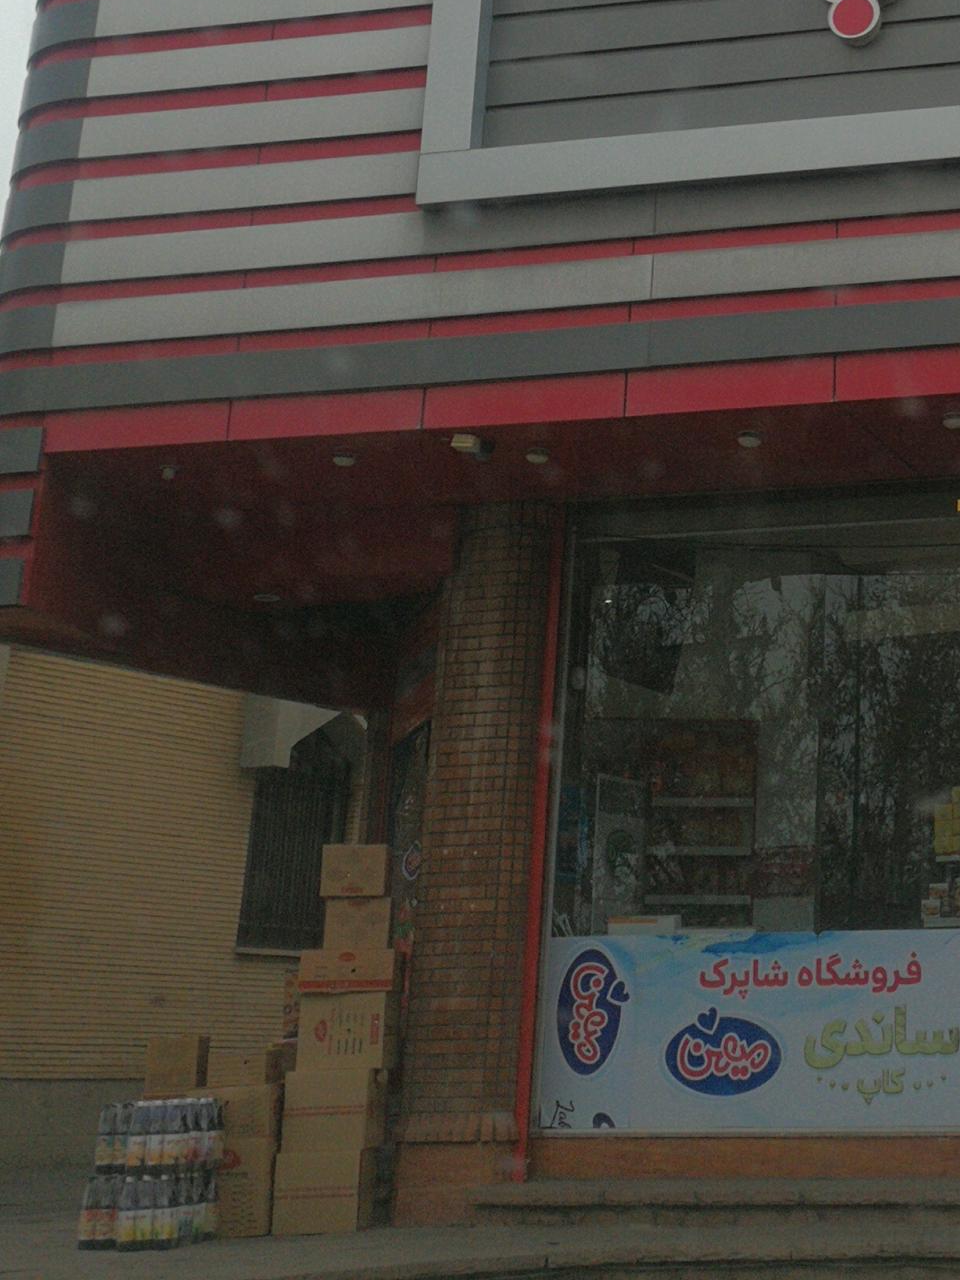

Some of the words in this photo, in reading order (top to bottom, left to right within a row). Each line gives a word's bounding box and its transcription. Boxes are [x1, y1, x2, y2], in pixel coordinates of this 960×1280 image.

[699, 957, 788, 1000] شاپرک
[796, 951, 923, 993] فروشگاه
[569, 962, 607, 1065] میهن
[676, 1032, 772, 1081] میهن
[803, 1004, 960, 1071] ساندی
[856, 1068, 905, 1106] کاپ
